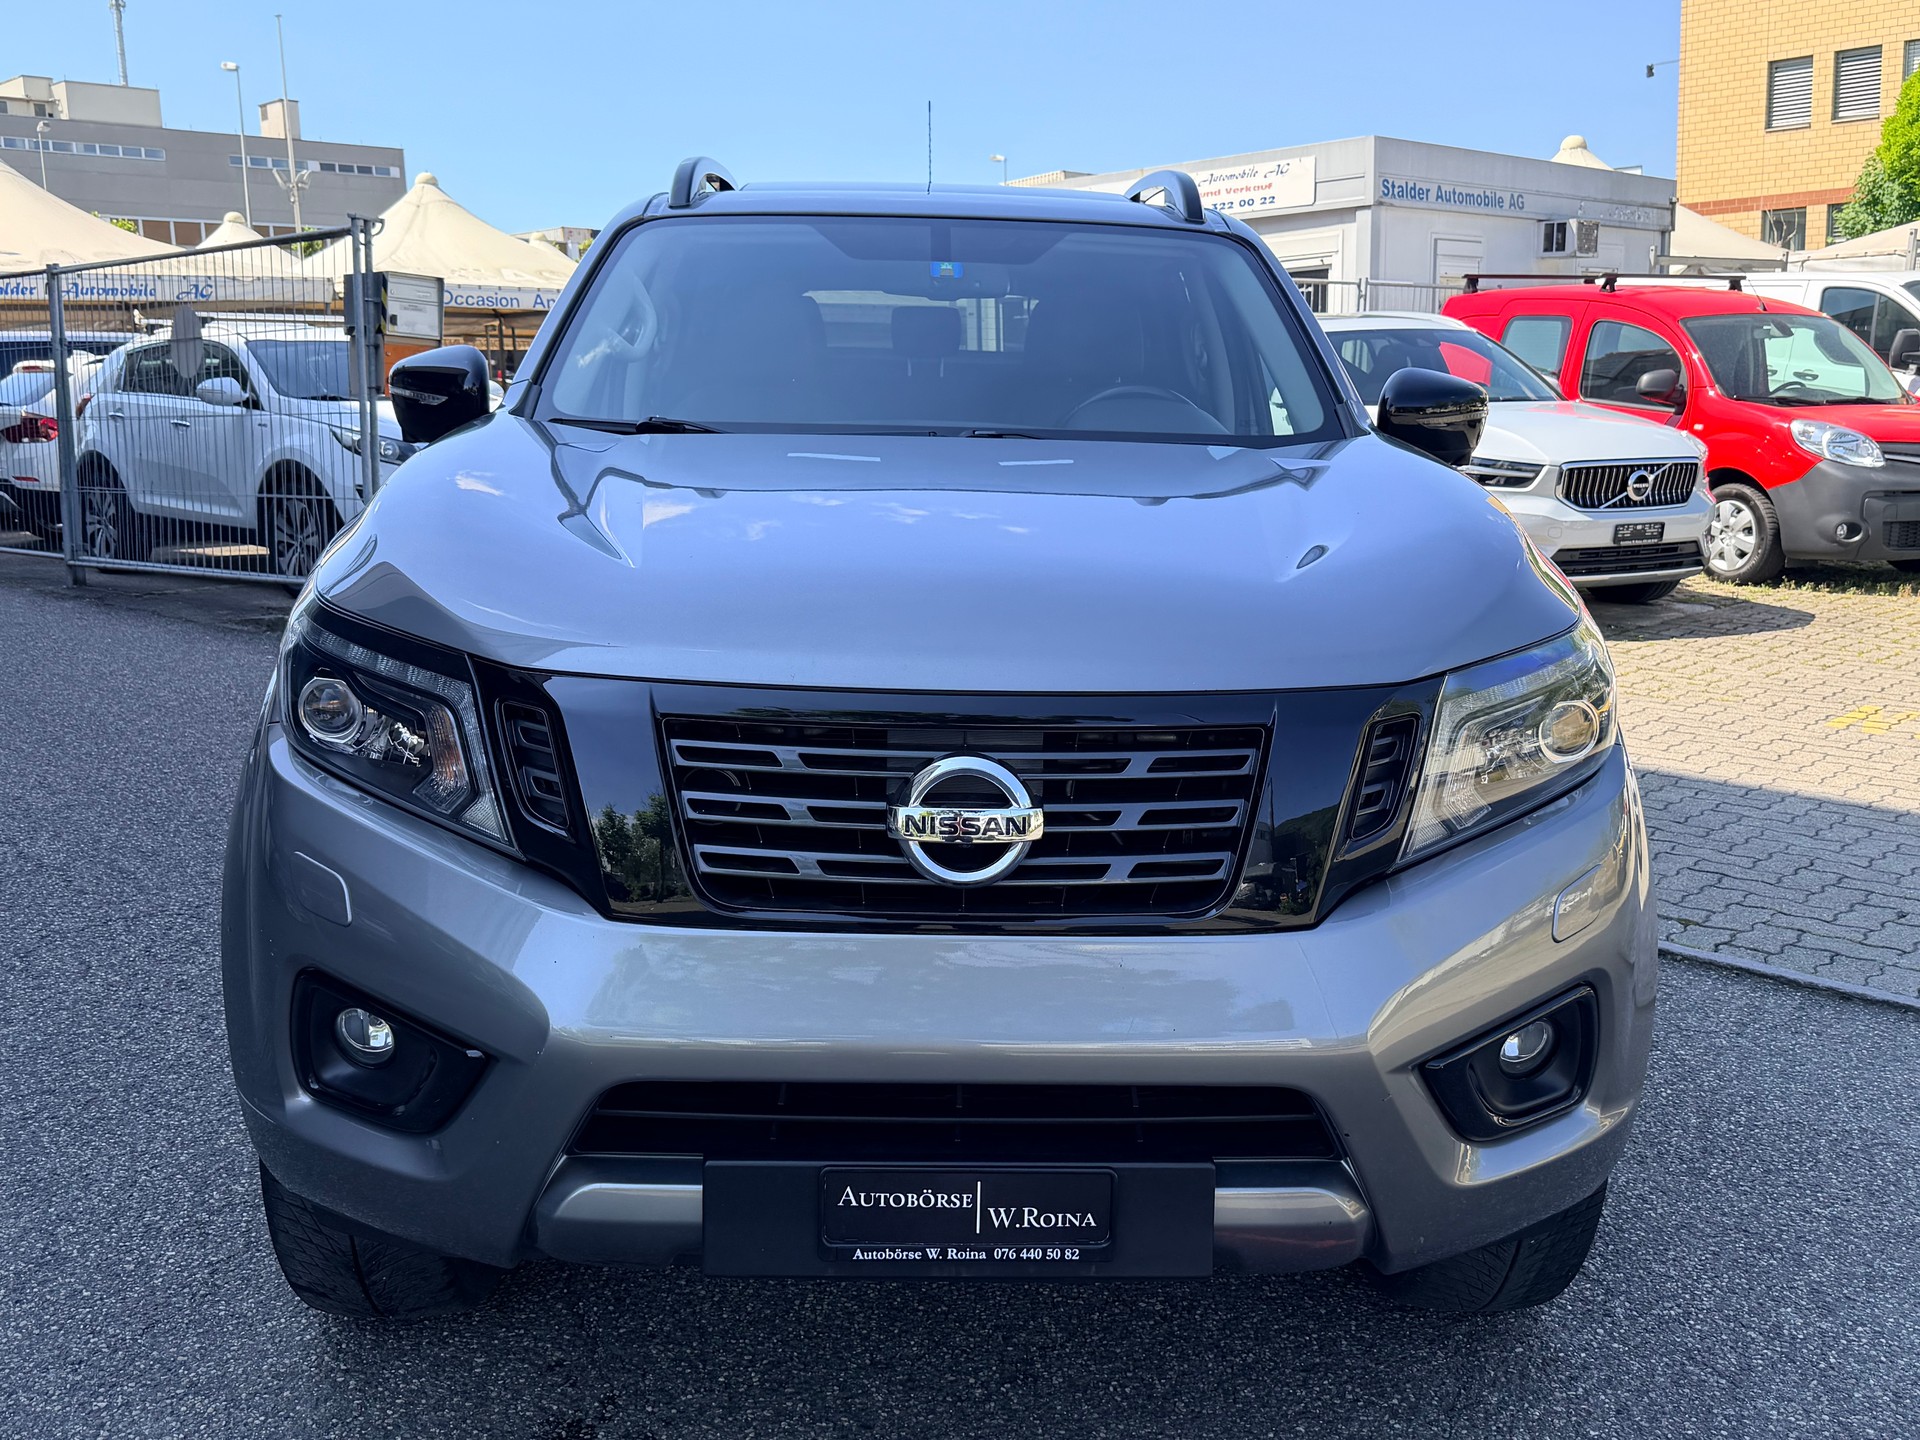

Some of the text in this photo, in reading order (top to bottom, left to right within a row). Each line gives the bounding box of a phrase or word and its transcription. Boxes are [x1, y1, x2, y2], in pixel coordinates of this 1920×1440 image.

[1198, 166, 1258, 187] Automobile
[1200, 182, 1273, 198] und Verkauf
[1382, 178, 1525, 210] Stalder Automobile AG
[1239, 198, 1255, 208] 00
[1260, 195, 1276, 205] 22
[62, 282, 157, 298] Automobile
[176, 283, 214, 301] AG
[444, 290, 520, 308] Occasion
[903, 814, 1027, 836] NISSAN
[837, 1186, 973, 1208] AUTOBÖRSE
[852, 1248, 1080, 1260] Autobörse W. Roina 076 440 50 82
